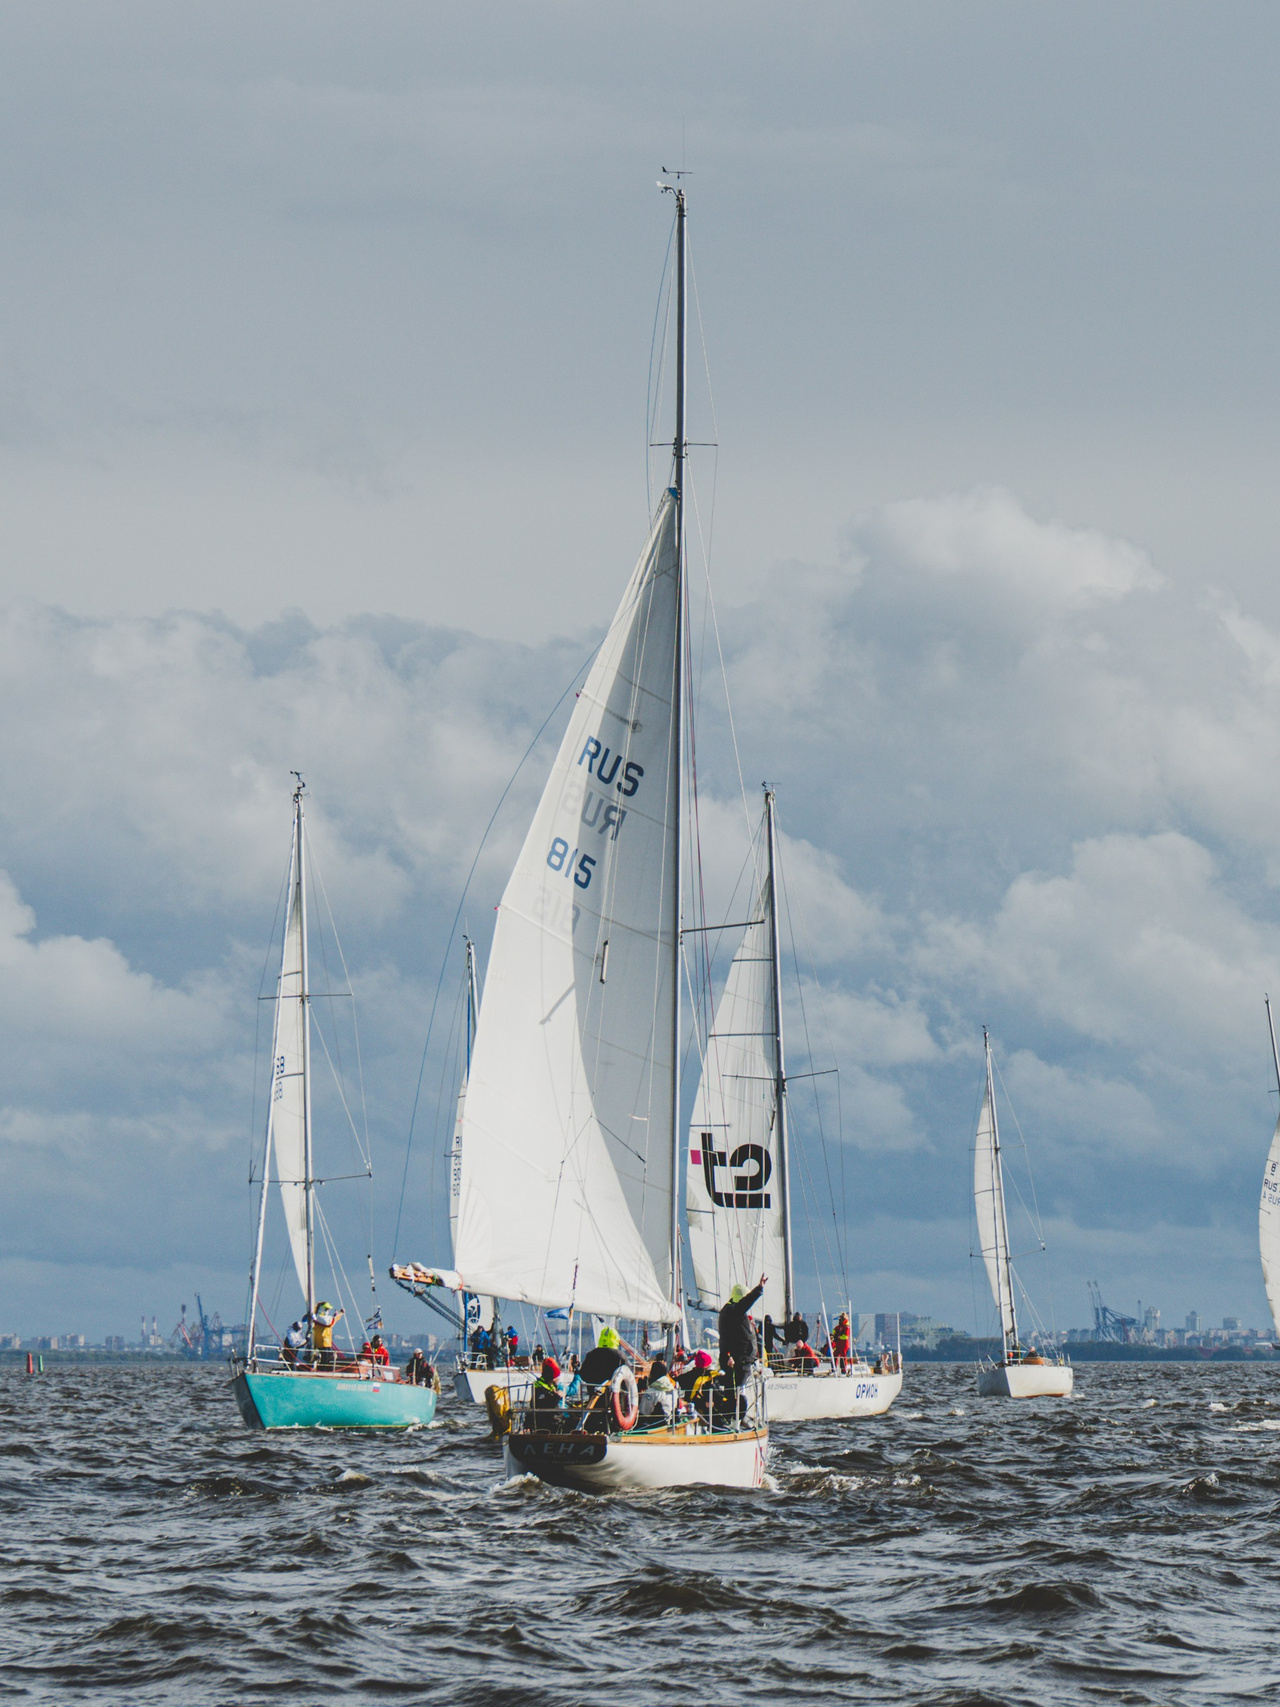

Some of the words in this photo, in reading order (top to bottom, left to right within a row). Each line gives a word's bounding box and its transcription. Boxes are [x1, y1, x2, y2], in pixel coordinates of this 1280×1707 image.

[577, 735, 645, 797] RUS
[546, 836, 597, 890] 815
[1263, 1178, 1278, 1193] RUS
[855, 1383, 879, 1399] ОРИОН
